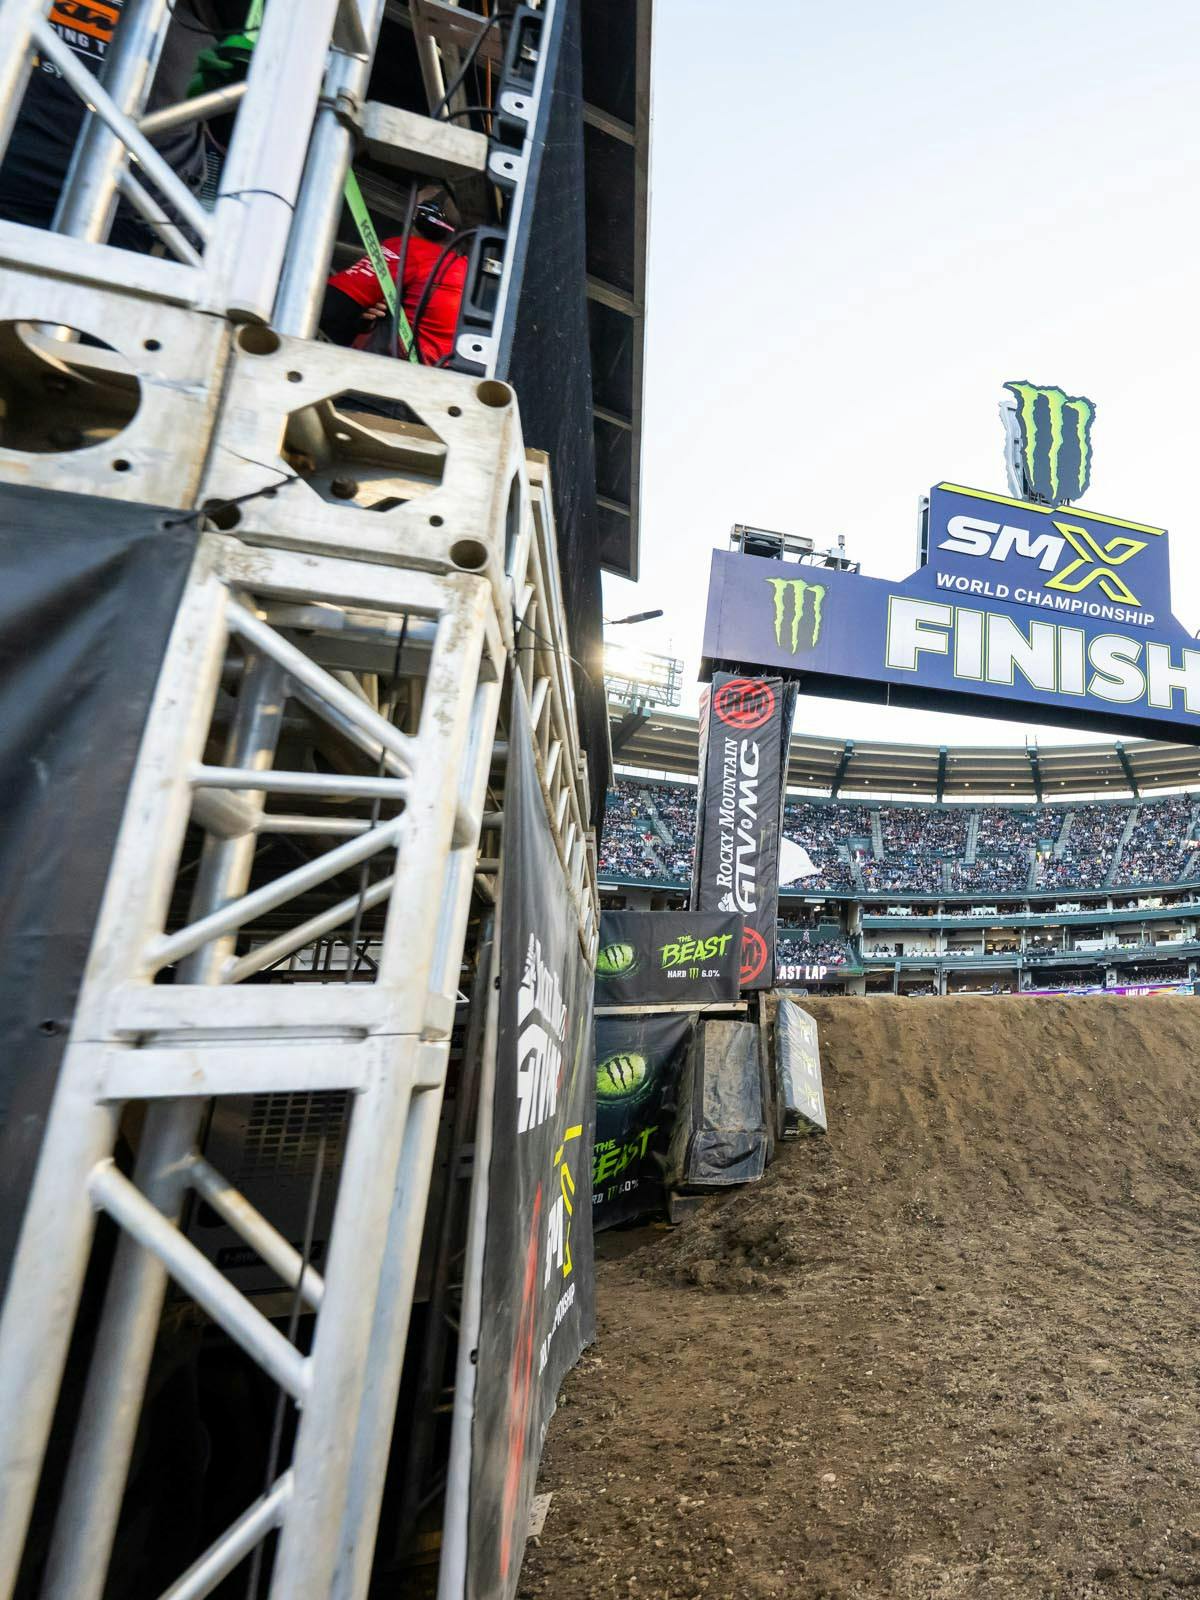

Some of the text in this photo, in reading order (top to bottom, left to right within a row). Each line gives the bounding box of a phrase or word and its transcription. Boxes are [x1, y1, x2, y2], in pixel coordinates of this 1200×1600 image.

[359, 219, 387, 280] KEEPER
[937, 515, 1149, 607] SMX
[936, 572, 1155, 626] WORLD CHAMPIONSHIP
[717, 737, 739, 888] ROCKY MOUNTAIN
[660, 934, 733, 969] BEAST
[676, 935, 693, 944] THE
[667, 969, 720, 978] HARD 6.0%
[776, 965, 828, 980] AST LAP
[593, 1139, 616, 1153] THE
